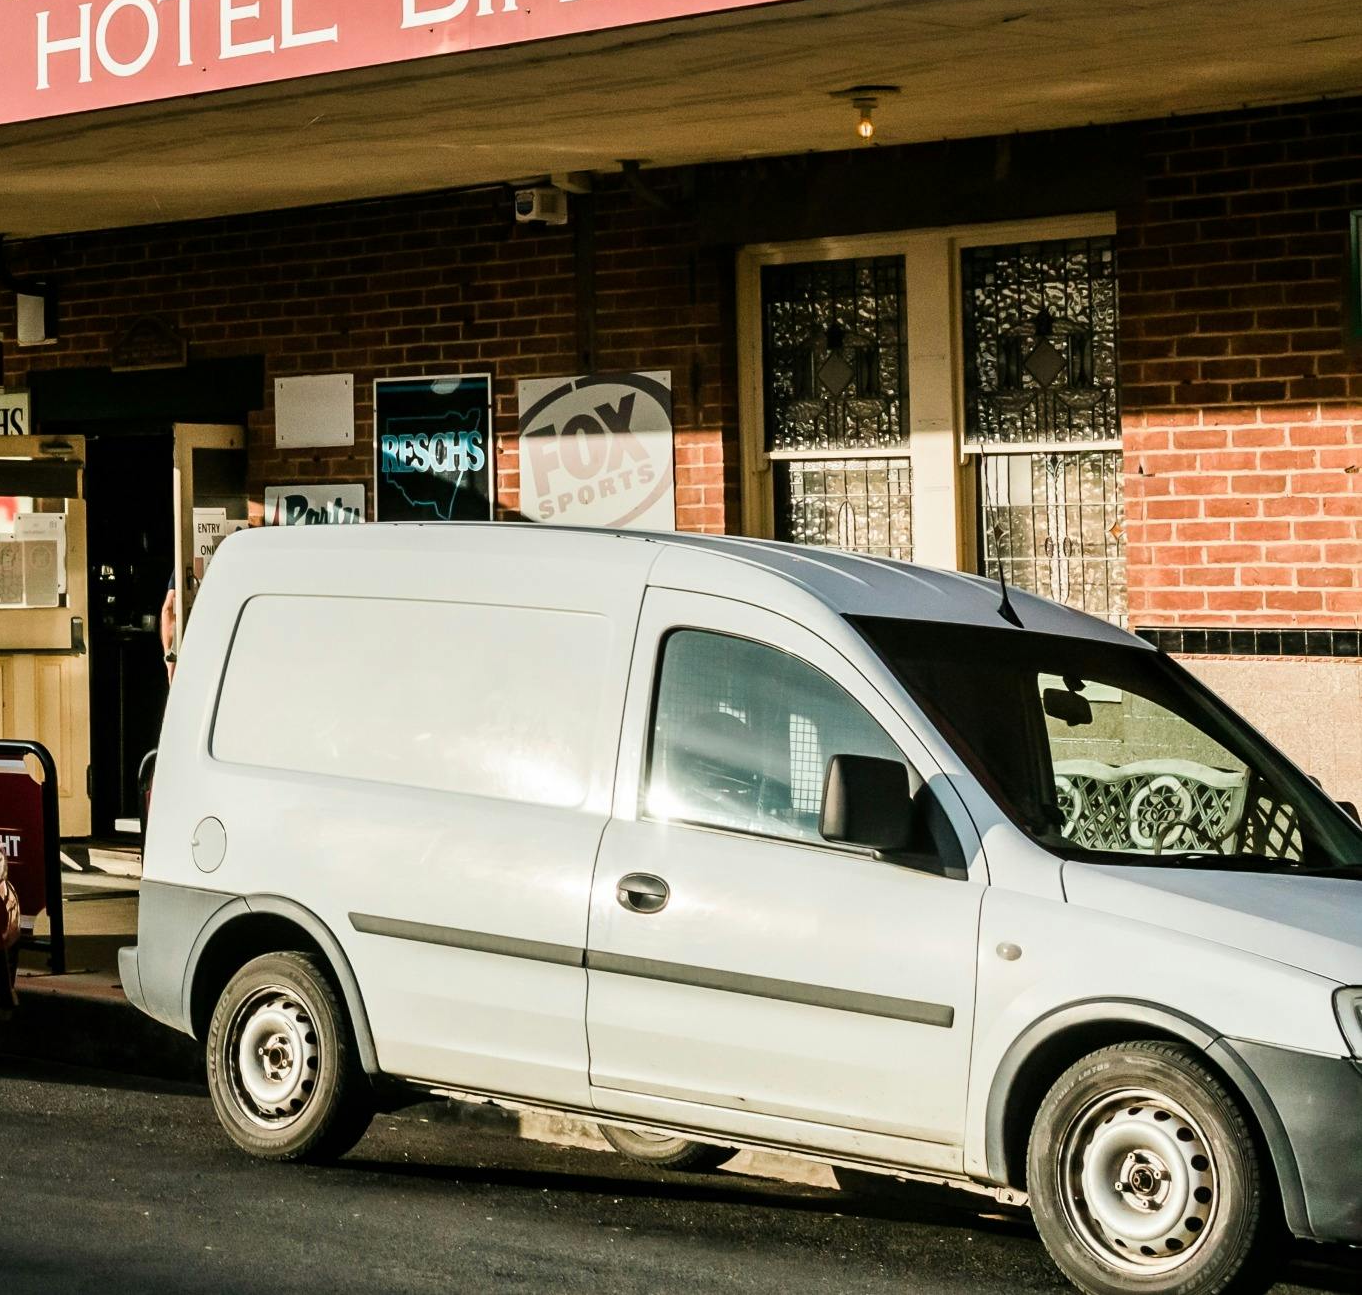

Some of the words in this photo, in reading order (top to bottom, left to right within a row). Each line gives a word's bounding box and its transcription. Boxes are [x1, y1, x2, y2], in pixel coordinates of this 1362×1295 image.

[380, 430, 486, 474] RESCHS
[522, 391, 651, 499] FOX
[538, 462, 657, 521] SPORTS
[197, 522, 221, 534] ENTRY
